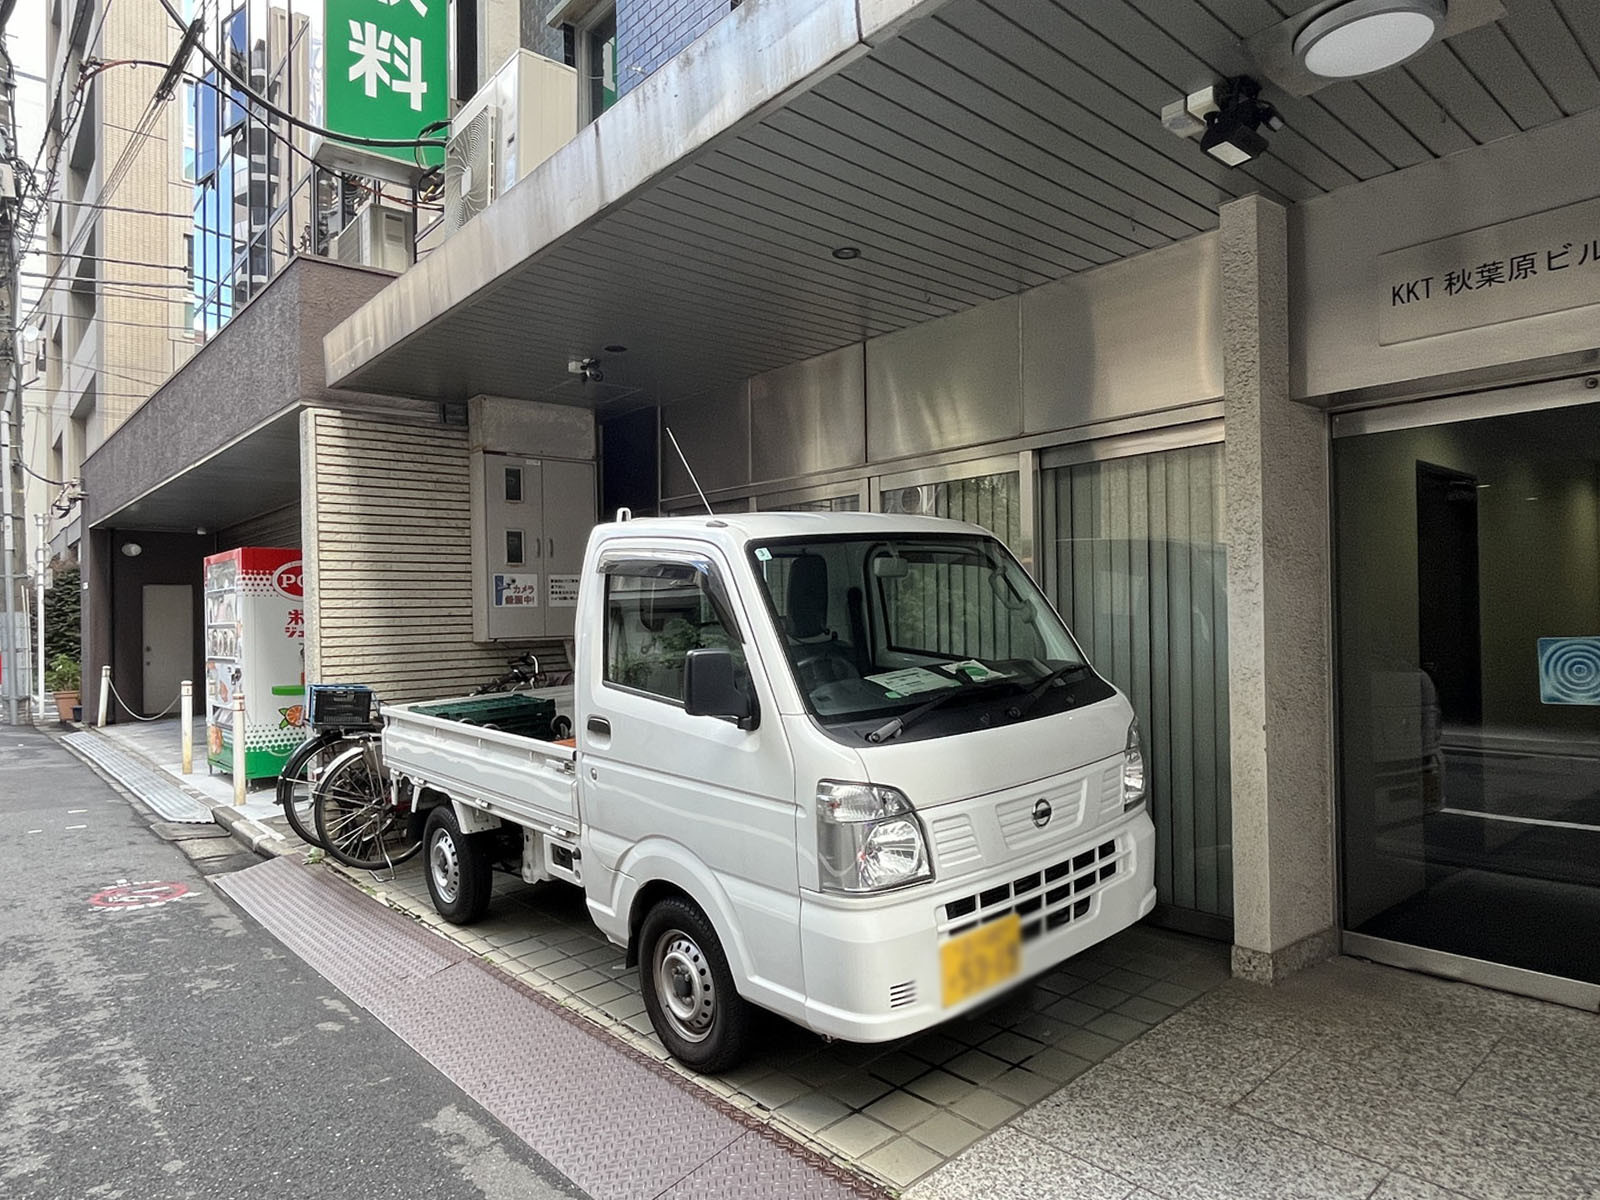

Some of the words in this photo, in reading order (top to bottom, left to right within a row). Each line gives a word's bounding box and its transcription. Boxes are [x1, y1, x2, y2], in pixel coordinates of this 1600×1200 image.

[348, 0, 428, 111] 料
[1392, 277, 1434, 306] KKT
[1443, 240, 1600, 296] 秋葉原ビル
[513, 584, 535, 594] カメラ
